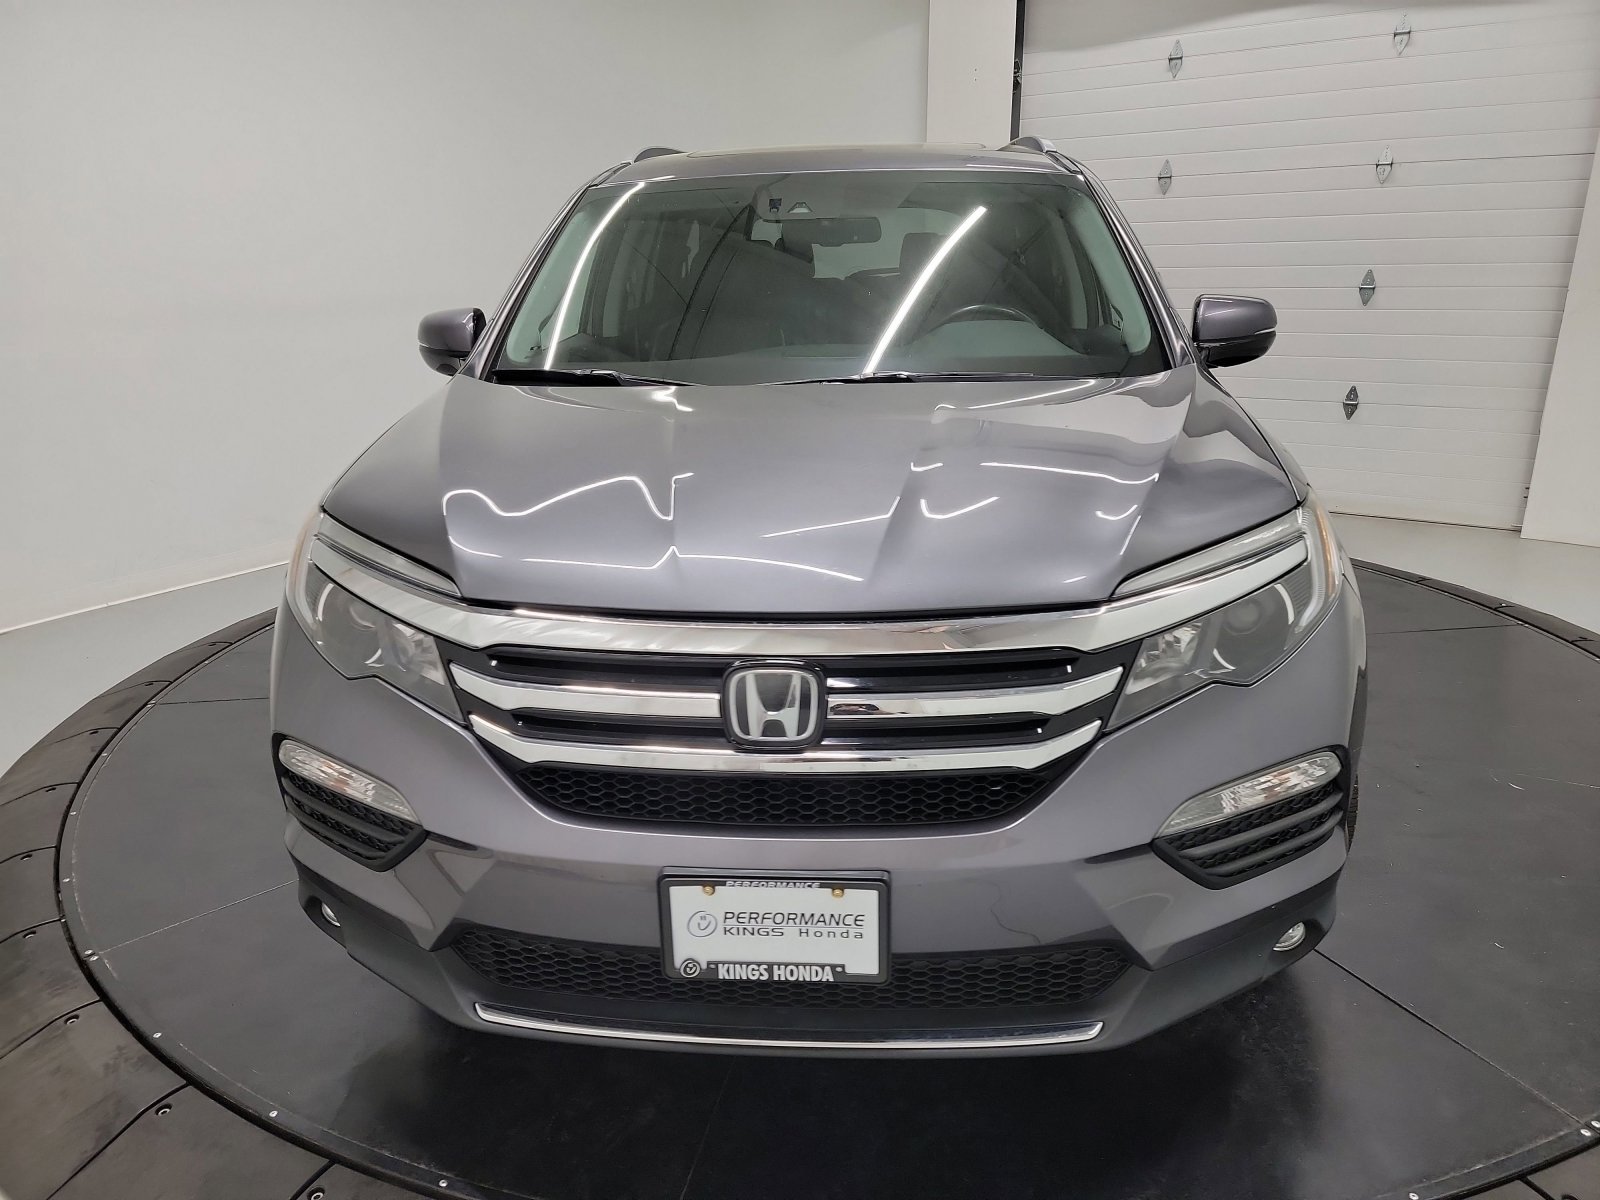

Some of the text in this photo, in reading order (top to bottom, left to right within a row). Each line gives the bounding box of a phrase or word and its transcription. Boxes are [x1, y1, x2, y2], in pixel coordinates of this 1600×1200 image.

[726, 881, 820, 889] PERFORMANCE
[723, 911, 865, 927] PERFORMANCE
[723, 927, 863, 939] KINGS Honda
[717, 963, 835, 982] KINGS HONDA
